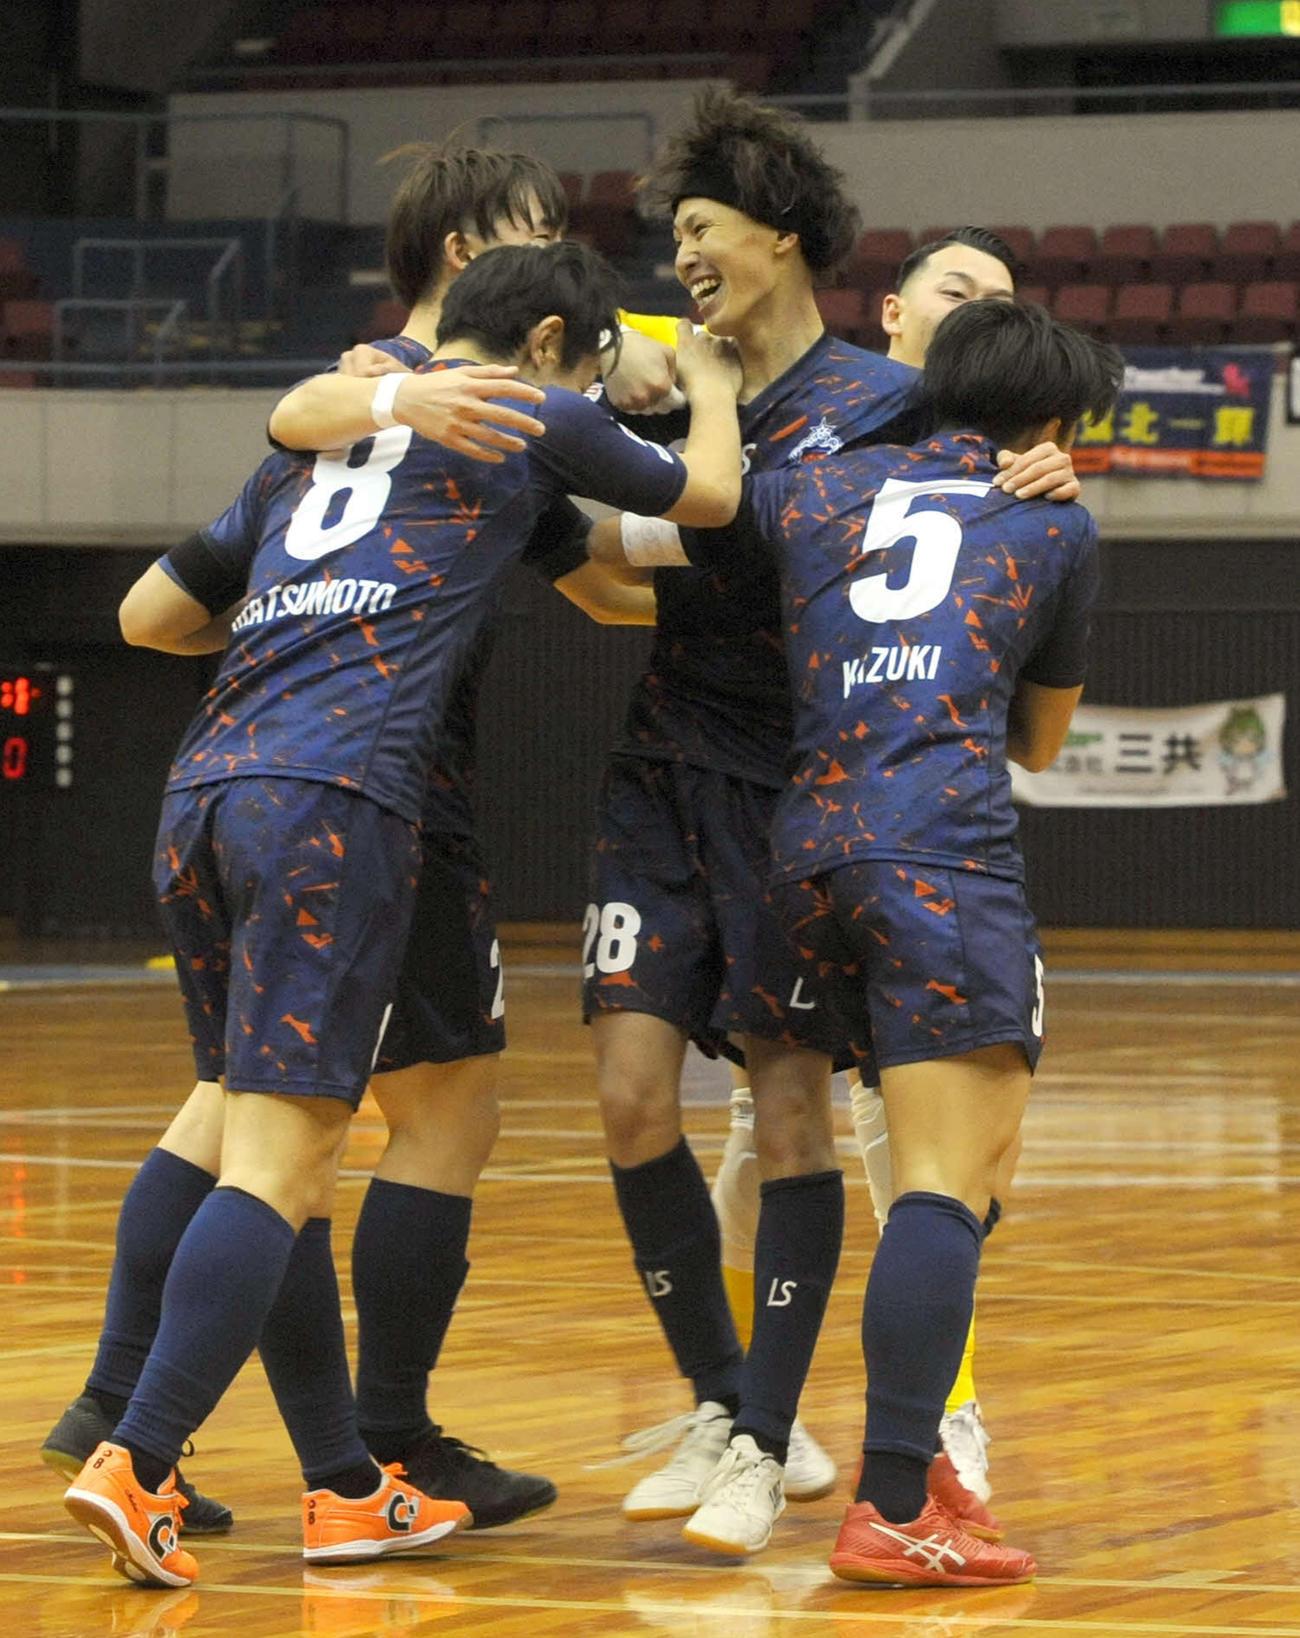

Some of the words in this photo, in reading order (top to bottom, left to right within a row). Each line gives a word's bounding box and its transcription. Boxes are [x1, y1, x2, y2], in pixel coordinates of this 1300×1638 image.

[284, 424, 413, 561] 8
[849, 478, 996, 624] 5
[582, 901, 642, 978] 28
